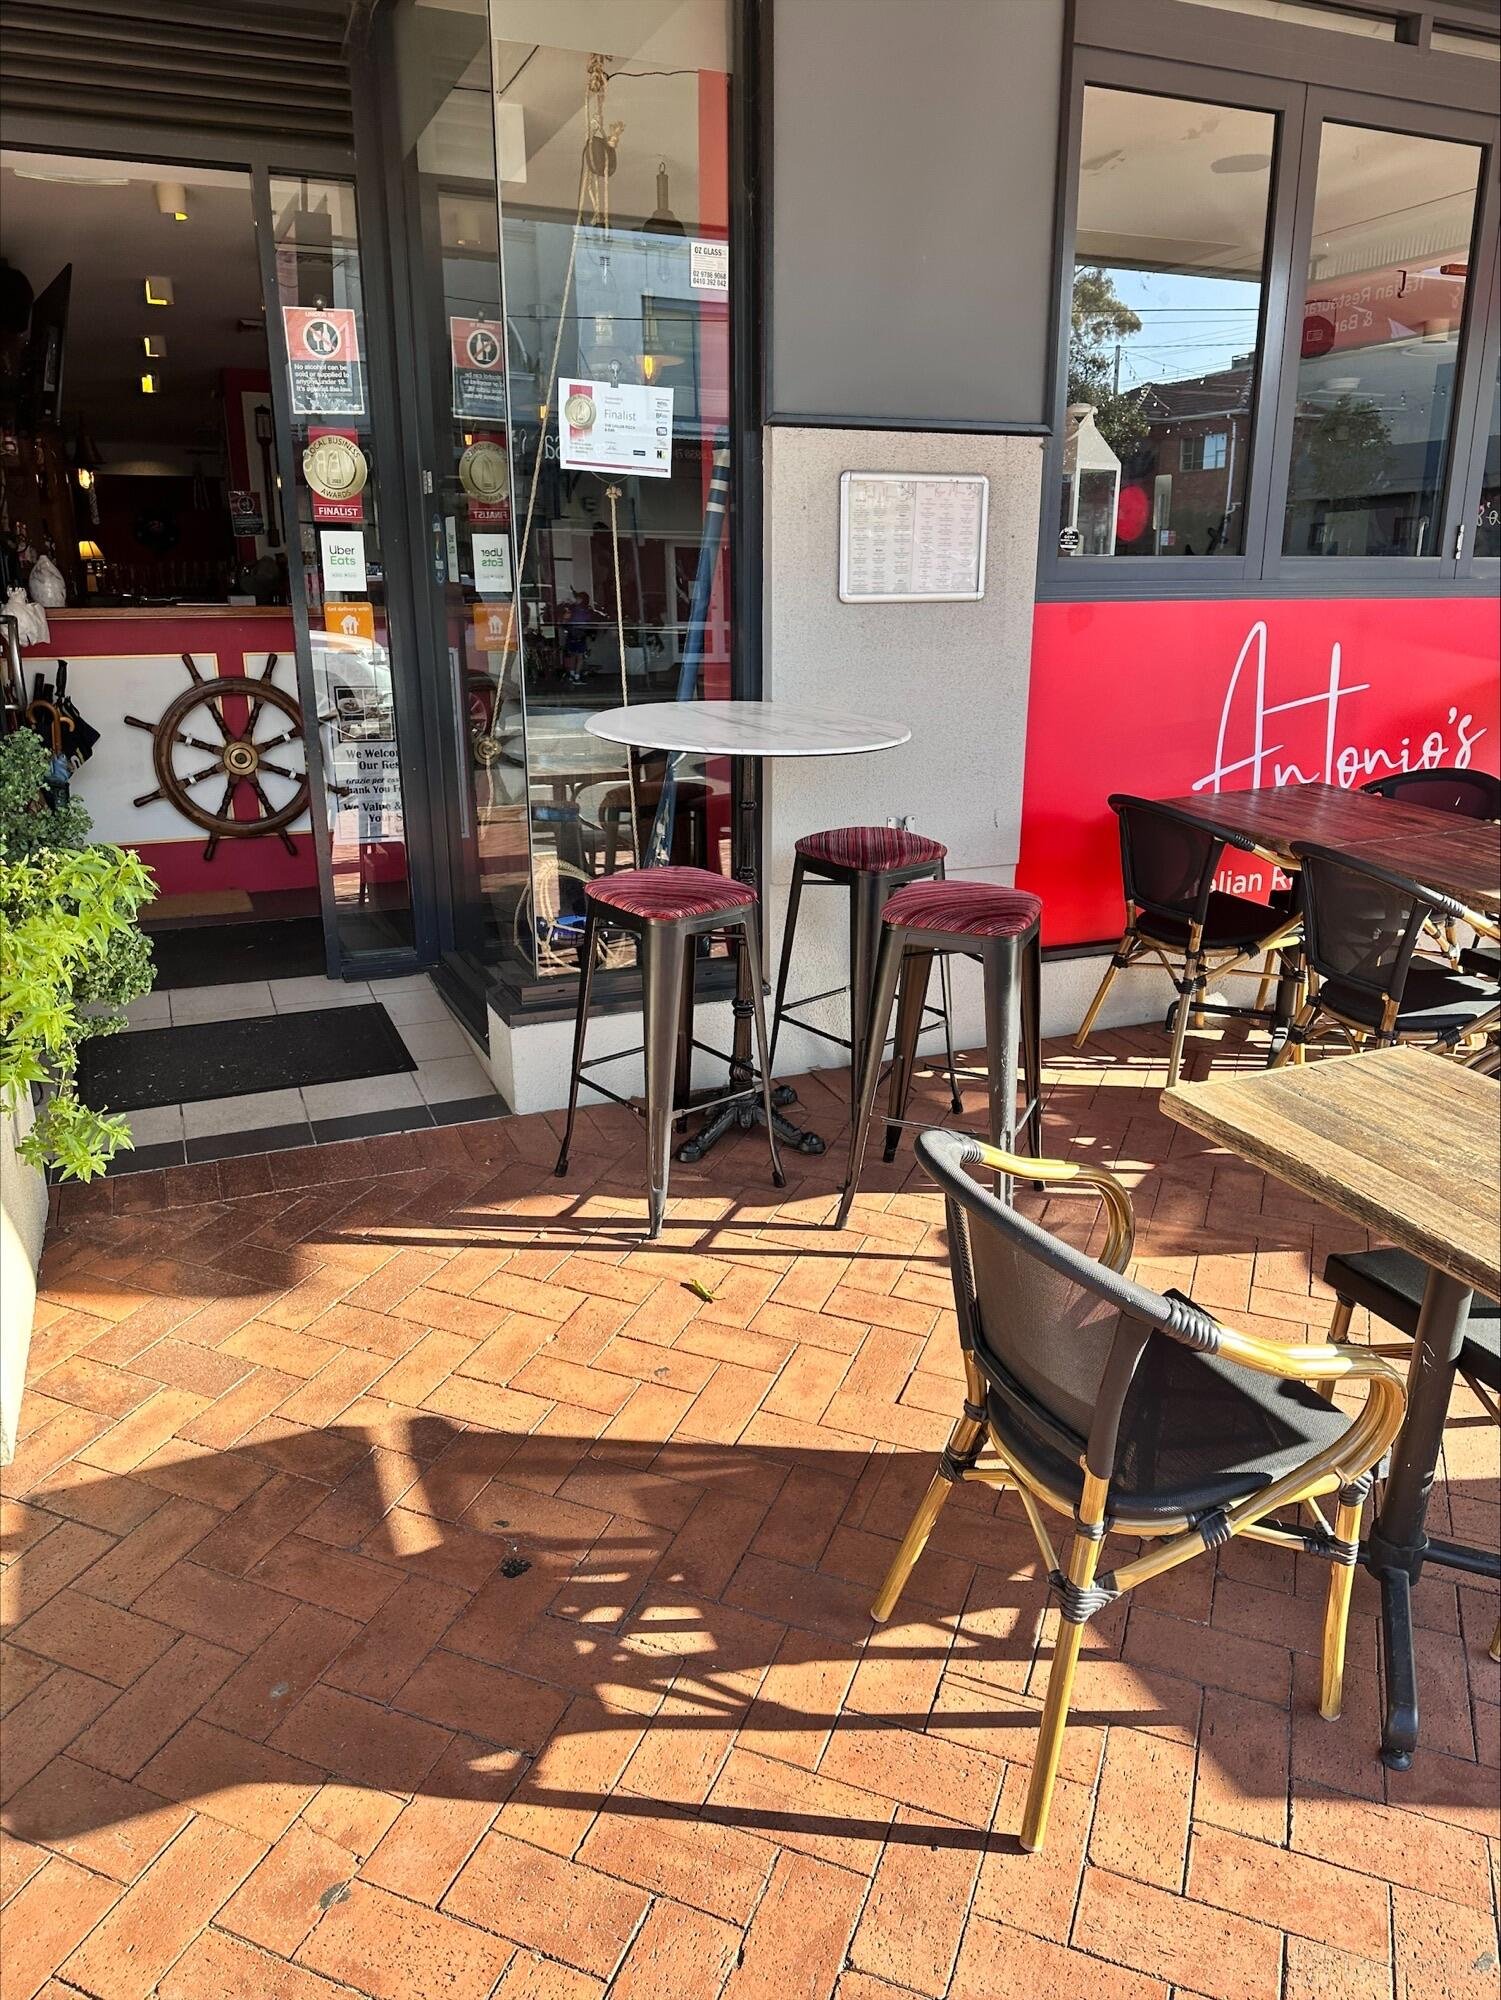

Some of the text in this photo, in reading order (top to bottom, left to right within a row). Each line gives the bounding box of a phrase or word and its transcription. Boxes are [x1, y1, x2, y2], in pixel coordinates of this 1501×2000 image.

[704, 248, 722, 256] GLASS
[604, 409, 636, 421] Finalist
[310, 437, 360, 458] LOCAL BUSINESS
[321, 488, 352, 499] AWARDS
[318, 507, 358, 516] FINALIST
[329, 545, 355, 555] Uber
[330, 556, 356, 566] Eats
[1192, 620, 1487, 792] Antonio's
[346, 750, 362, 758] We
[359, 761, 378, 770] Our
